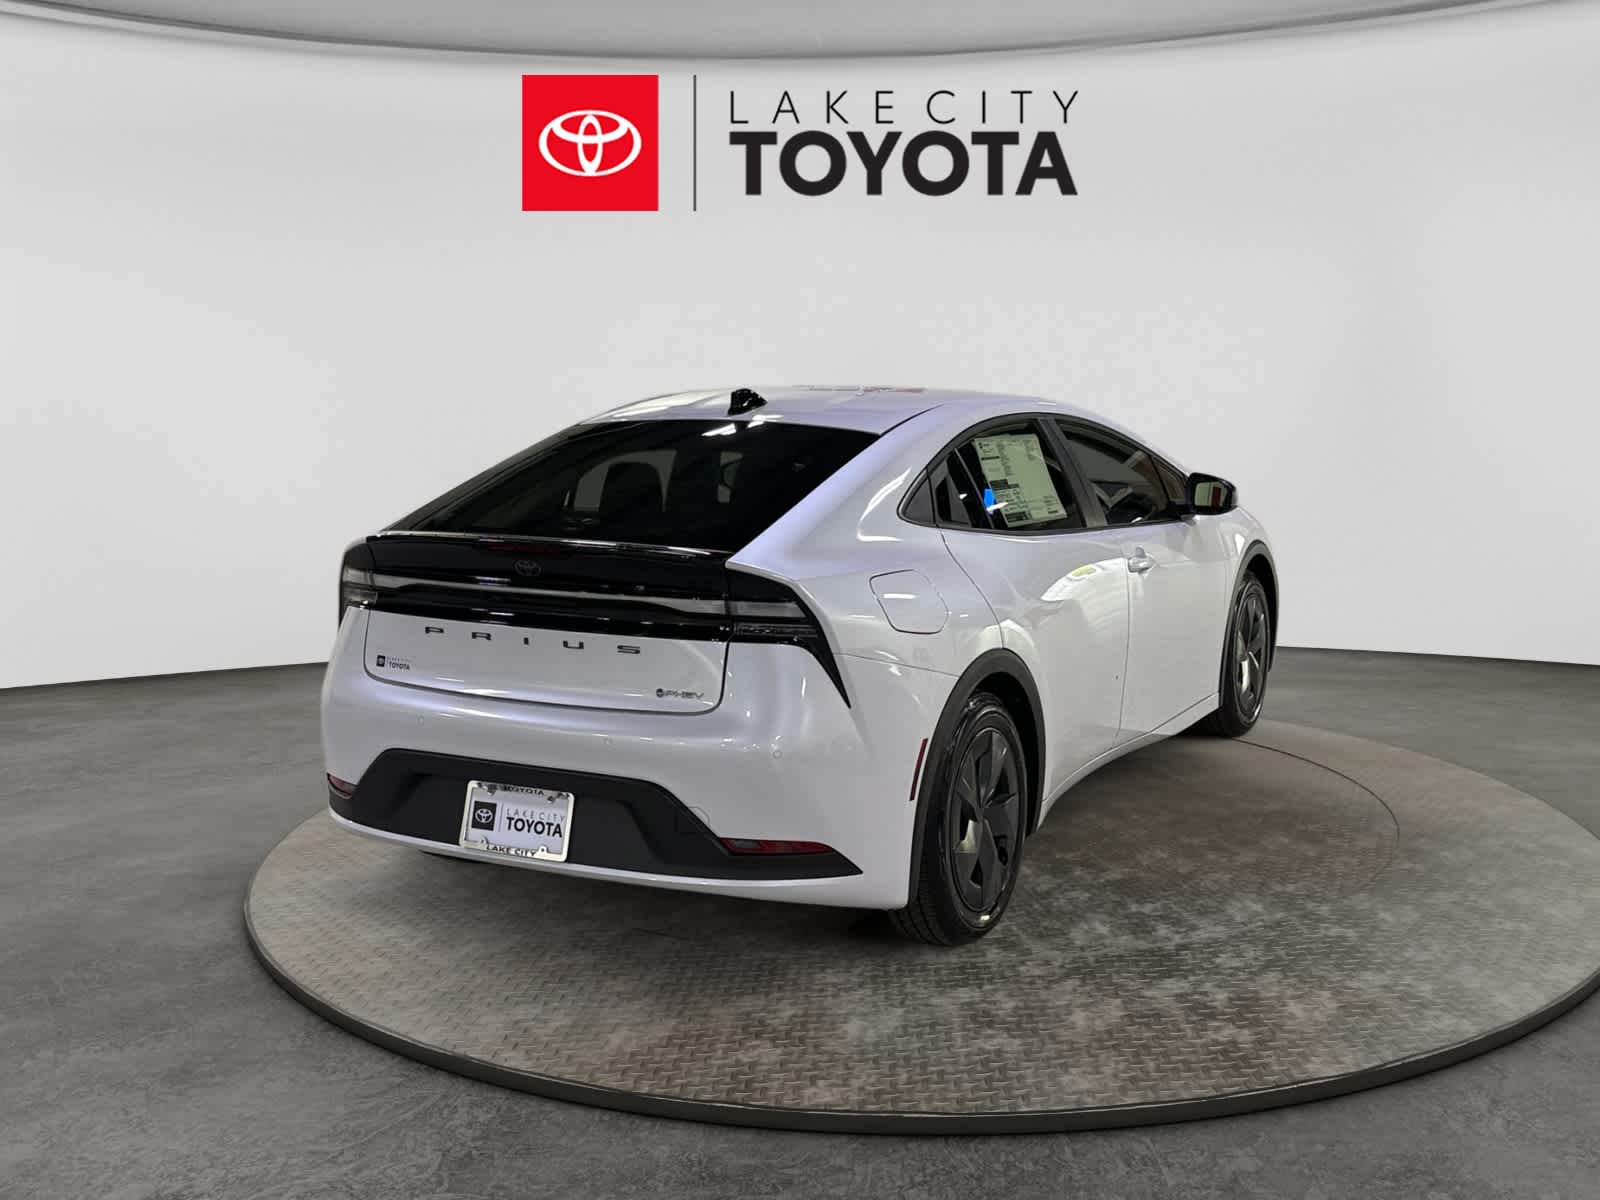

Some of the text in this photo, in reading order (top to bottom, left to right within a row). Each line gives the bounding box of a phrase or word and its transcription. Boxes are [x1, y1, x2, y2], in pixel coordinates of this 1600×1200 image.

[425, 626, 640, 655] PRIUS
[506, 808, 566, 823] LAKE CITY
[505, 816, 563, 838] TOYOTA
[486, 844, 538, 857] LAKE CITY
